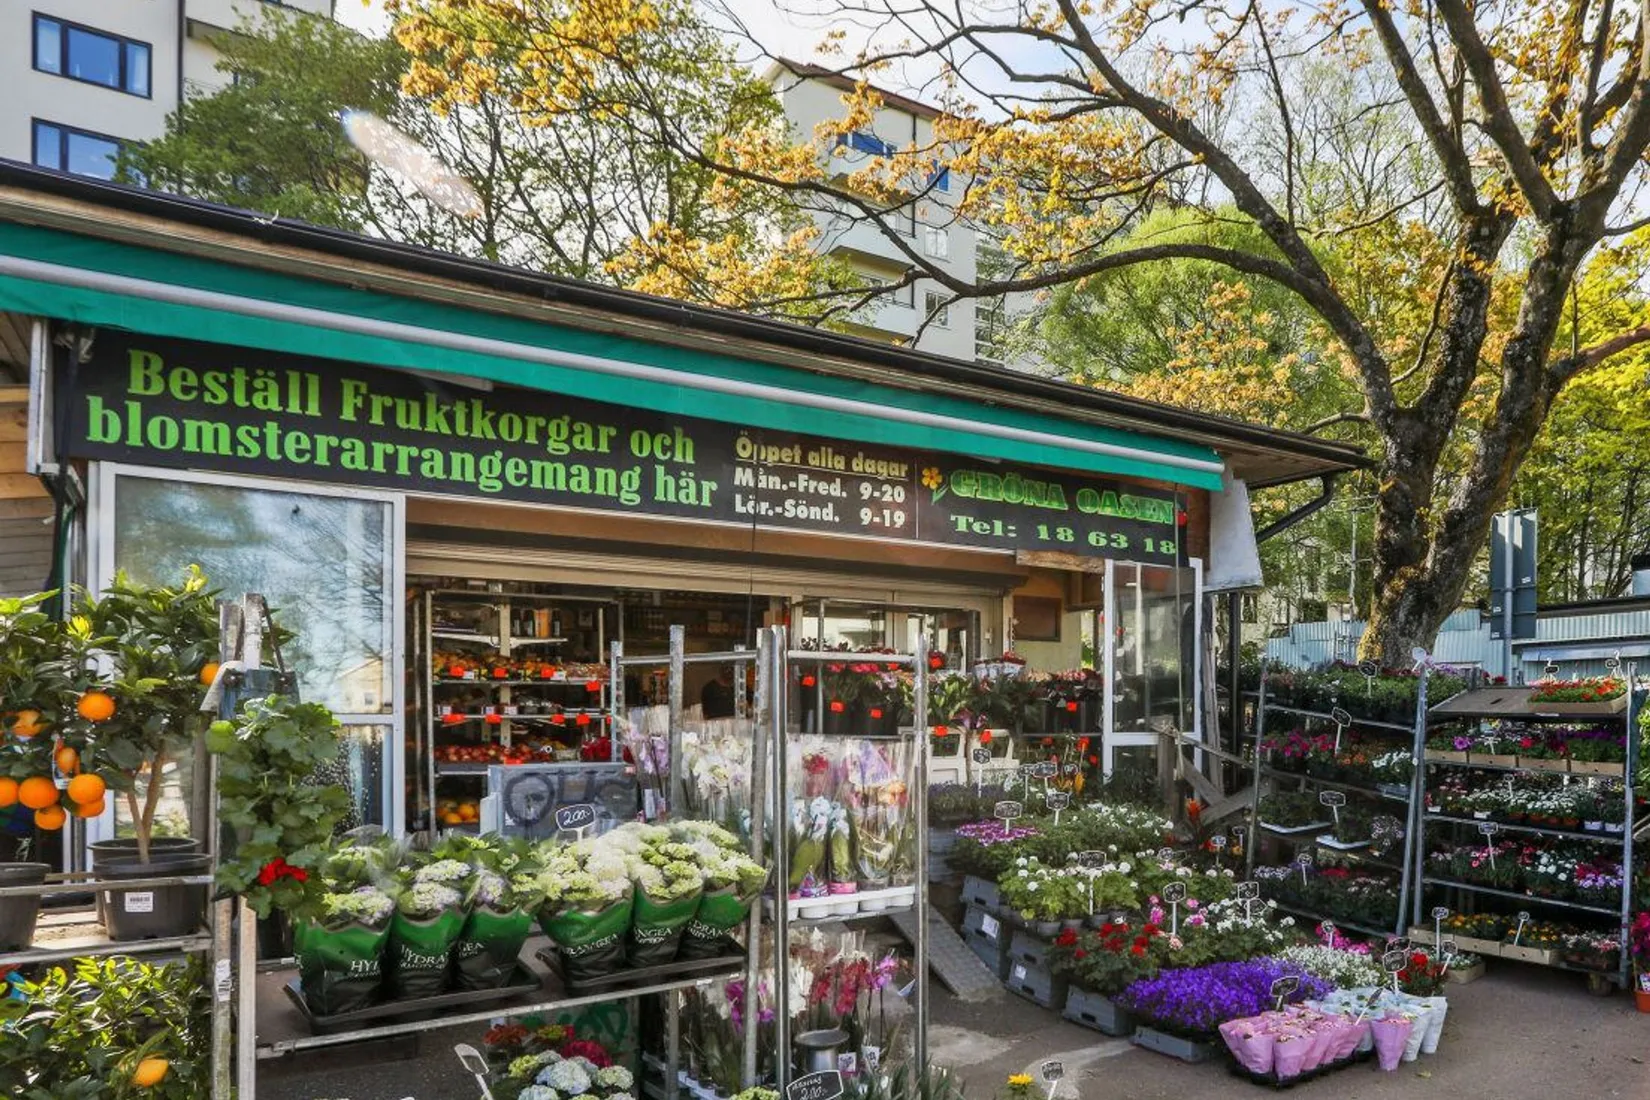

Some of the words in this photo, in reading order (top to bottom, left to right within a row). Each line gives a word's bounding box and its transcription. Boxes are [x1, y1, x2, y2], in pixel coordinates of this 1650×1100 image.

[127, 349, 321, 417] Beställ
[340, 378, 617, 456] Fruktkorgar
[630, 426, 695, 464] och
[86, 394, 641, 505] blomsterarrangemang
[654, 464, 718, 507] här
[735, 430, 802, 467] Öppet
[807, 446, 846, 470] alla
[851, 452, 909, 480] dagar
[734, 467, 848, 498] Mån.-Fred.
[859, 482, 906, 504] 9-20
[951, 469, 1069, 511] GRÖNA
[1076, 488, 1174, 525] OASEN
[734, 493, 840, 523] Lör.-Sönd.
[859, 507, 907, 529] 9-19
[950, 514, 1018, 538] Tel:
[1036, 524, 1075, 542] 18
[1088, 531, 1129, 549] 63
[1143, 537, 1177, 554] 18
